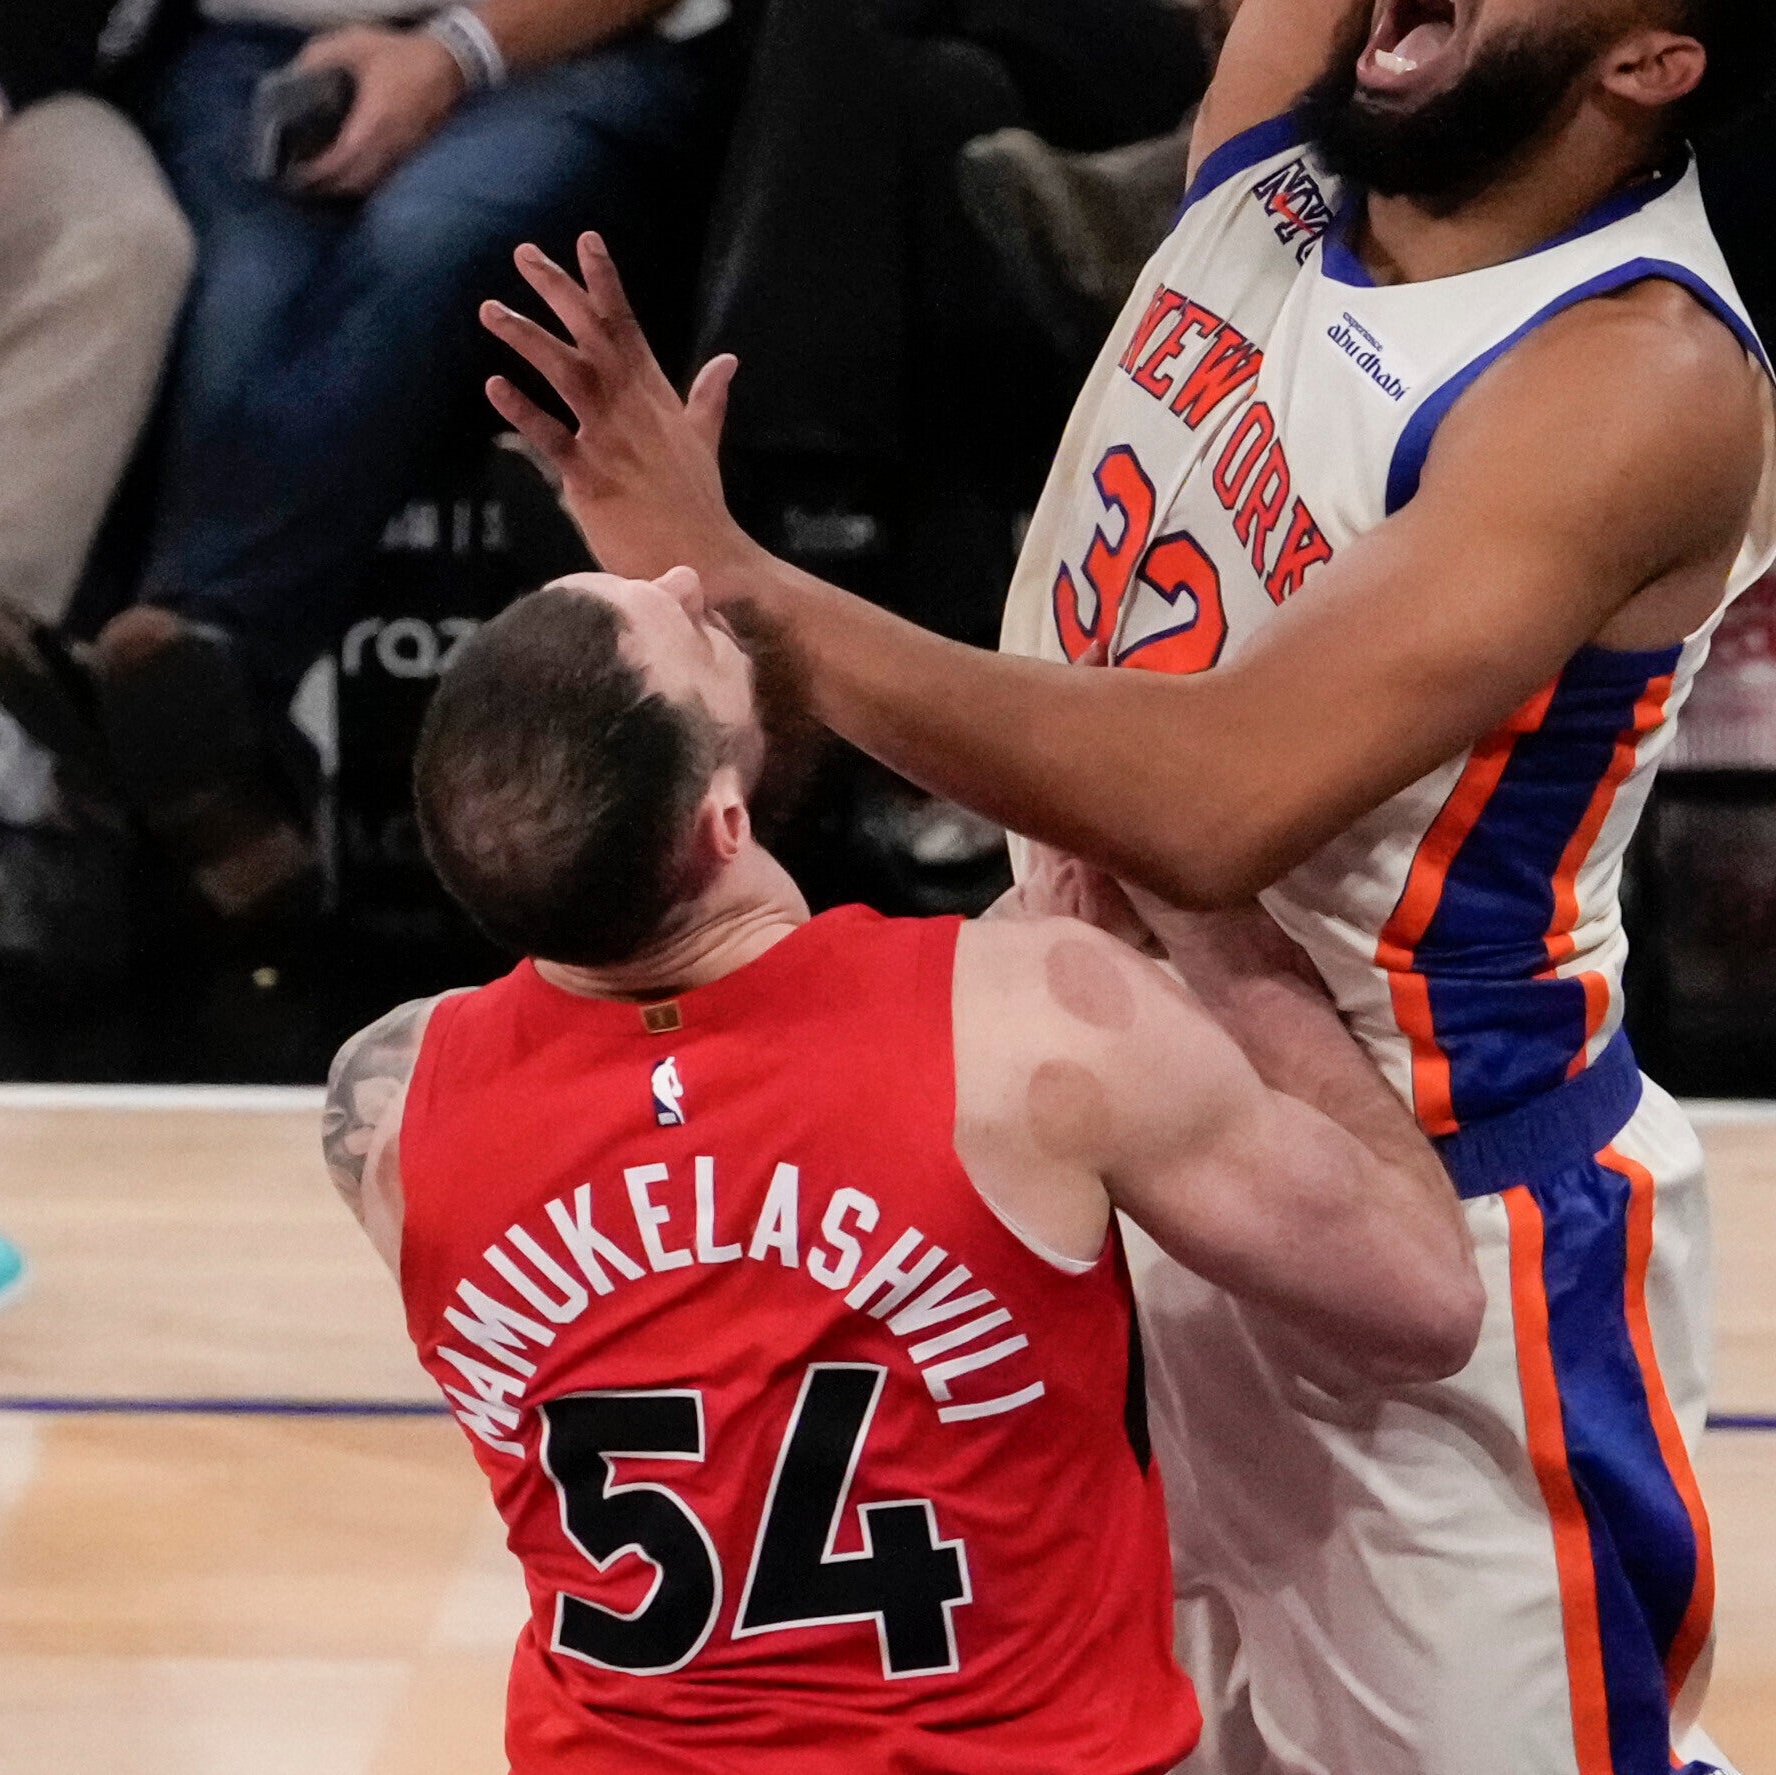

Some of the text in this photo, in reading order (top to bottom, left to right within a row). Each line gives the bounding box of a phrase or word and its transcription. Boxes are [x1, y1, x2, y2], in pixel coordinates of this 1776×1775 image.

[1118, 282, 1265, 432] NEW
[1327, 323, 1411, 403] abu dhabi
[1052, 443, 1229, 675] 32
[1211, 389, 1335, 607] ORK
[436, 1155, 1045, 1459] MAMUKELASHVILI
[536, 1361, 973, 1682] 54
